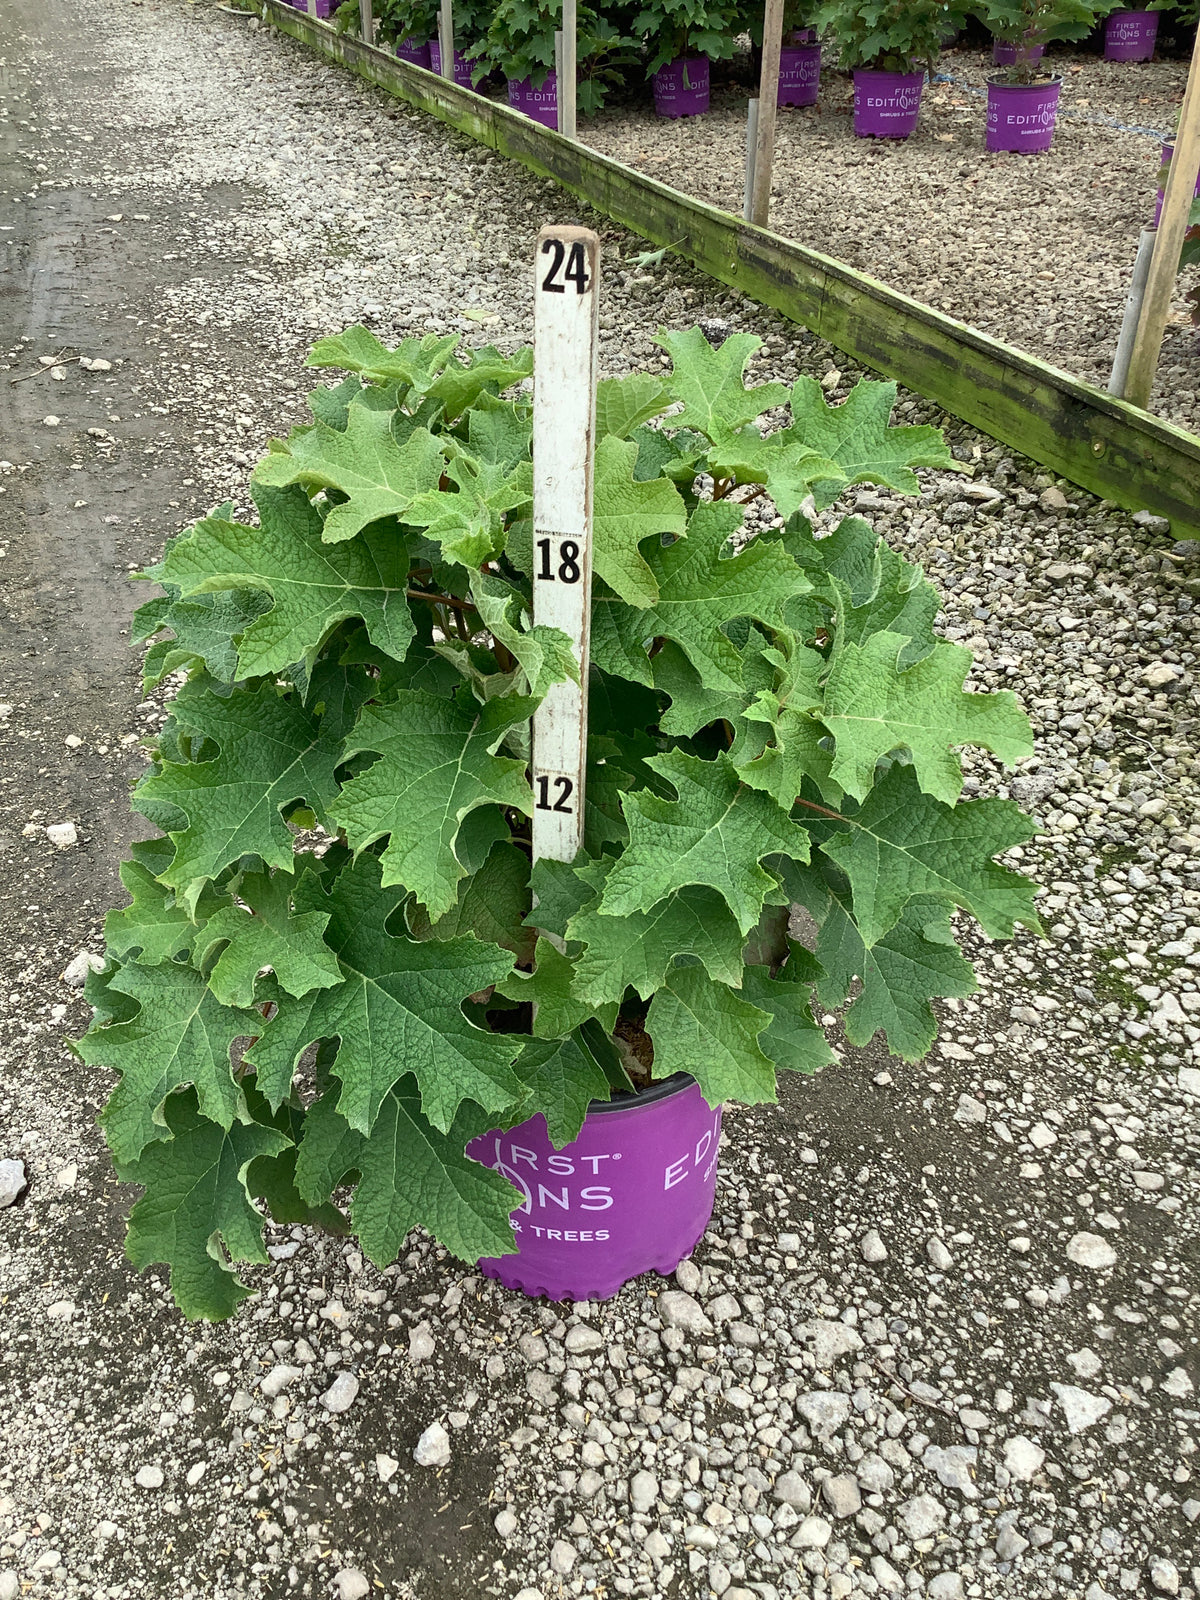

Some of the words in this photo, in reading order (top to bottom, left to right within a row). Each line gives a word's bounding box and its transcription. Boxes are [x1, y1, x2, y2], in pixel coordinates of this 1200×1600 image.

[1115, 22, 1141, 30] FIRST
[779, 68, 818, 80] DITIONS
[526, 92, 556, 101] EDITI
[894, 86, 920, 96] FIRST
[867, 96, 919, 109] EDITIONS
[1007, 110, 1057, 125] EDITIONS
[541, 239, 589, 294] 24
[537, 538, 580, 584] 18
[536, 776, 573, 814] 12
[530, 1225, 610, 1241] TREES
